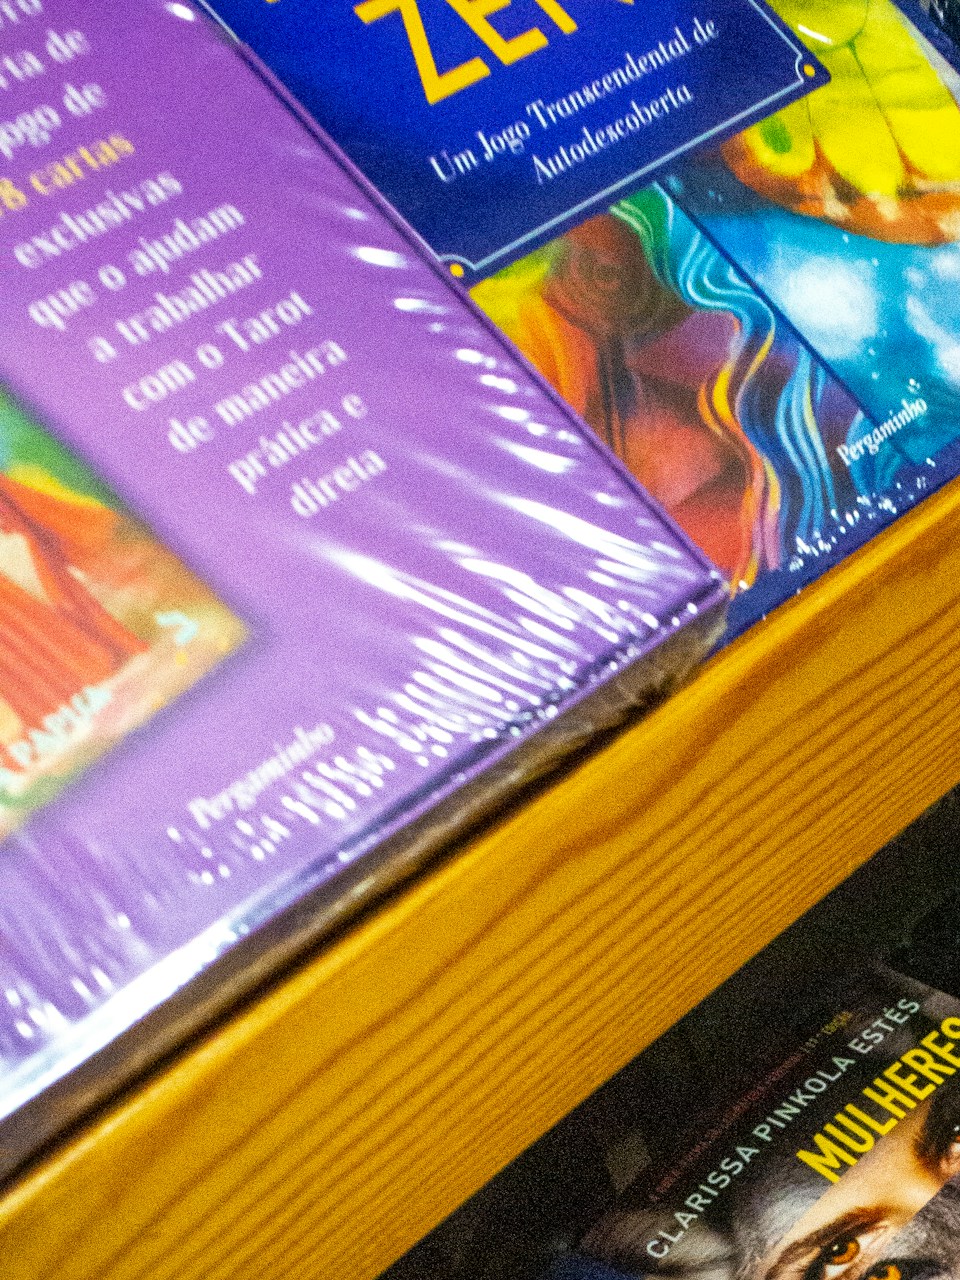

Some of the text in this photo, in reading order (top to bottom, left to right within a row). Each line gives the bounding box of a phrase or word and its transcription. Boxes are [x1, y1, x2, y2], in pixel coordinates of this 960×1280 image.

[46, 29, 90, 63] de
[63, 82, 107, 117] de
[428, 15, 719, 185] Um Jogo Transcendental de
[531, 82, 694, 185] Autodescoberta
[30, 133, 136, 196] cartas
[14, 171, 183, 268] exclusivas
[28, 203, 245, 332] que o ajudam
[89, 254, 262, 363] a trabalhar
[122, 290, 313, 411] com o Tarot
[167, 340, 347, 453] de maneira
[228, 394, 367, 495] prática e
[836, 397, 928, 467] Pergaminho
[290, 449, 388, 517] direta
[646, 1144, 760, 1259] CLARISSA
[753, 1056, 855, 1142] PINKOLA
[848, 998, 921, 1054] ESTÉS
